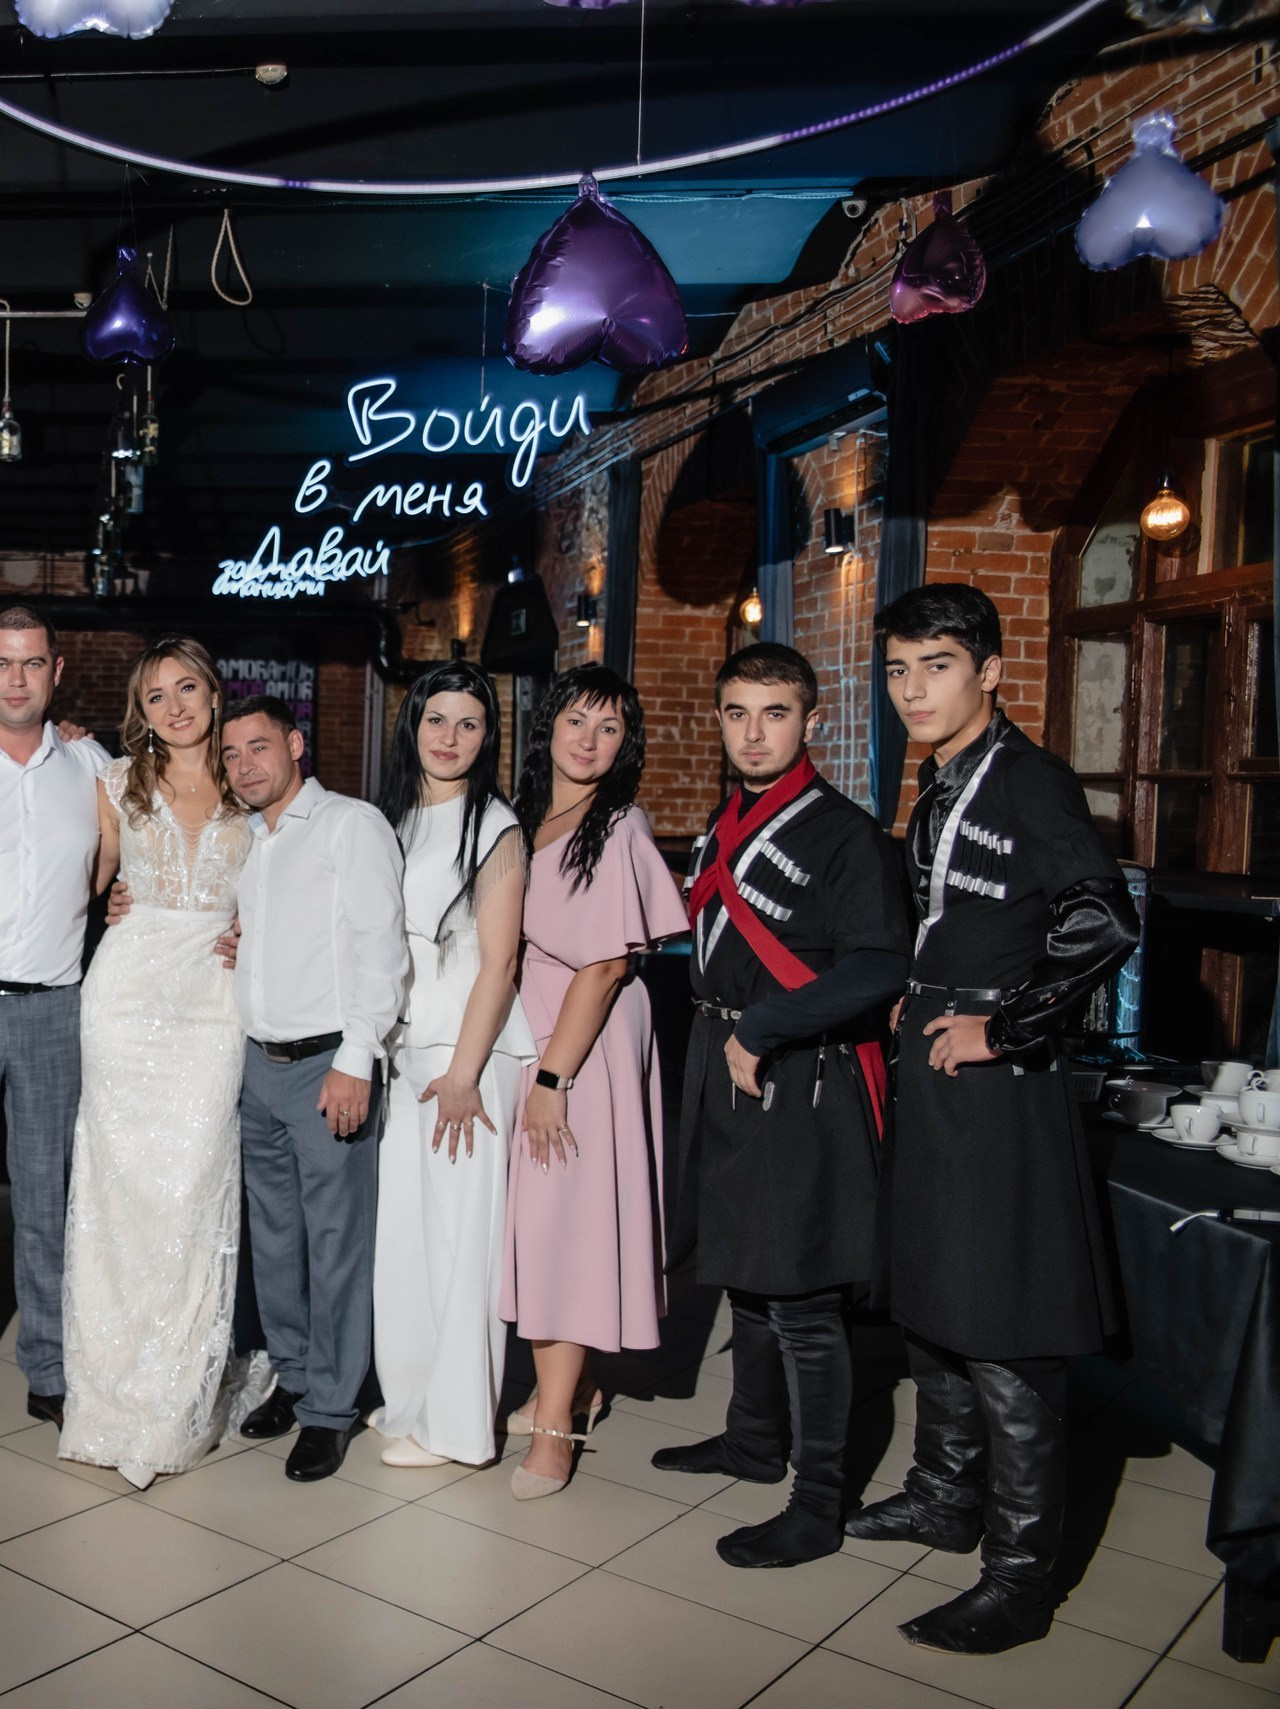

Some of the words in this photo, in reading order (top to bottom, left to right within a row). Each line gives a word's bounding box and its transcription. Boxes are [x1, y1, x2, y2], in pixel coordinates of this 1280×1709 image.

[347, 377, 590, 487] Войди
[352, 481, 488, 521] меня
[233, 525, 390, 588] Давай
